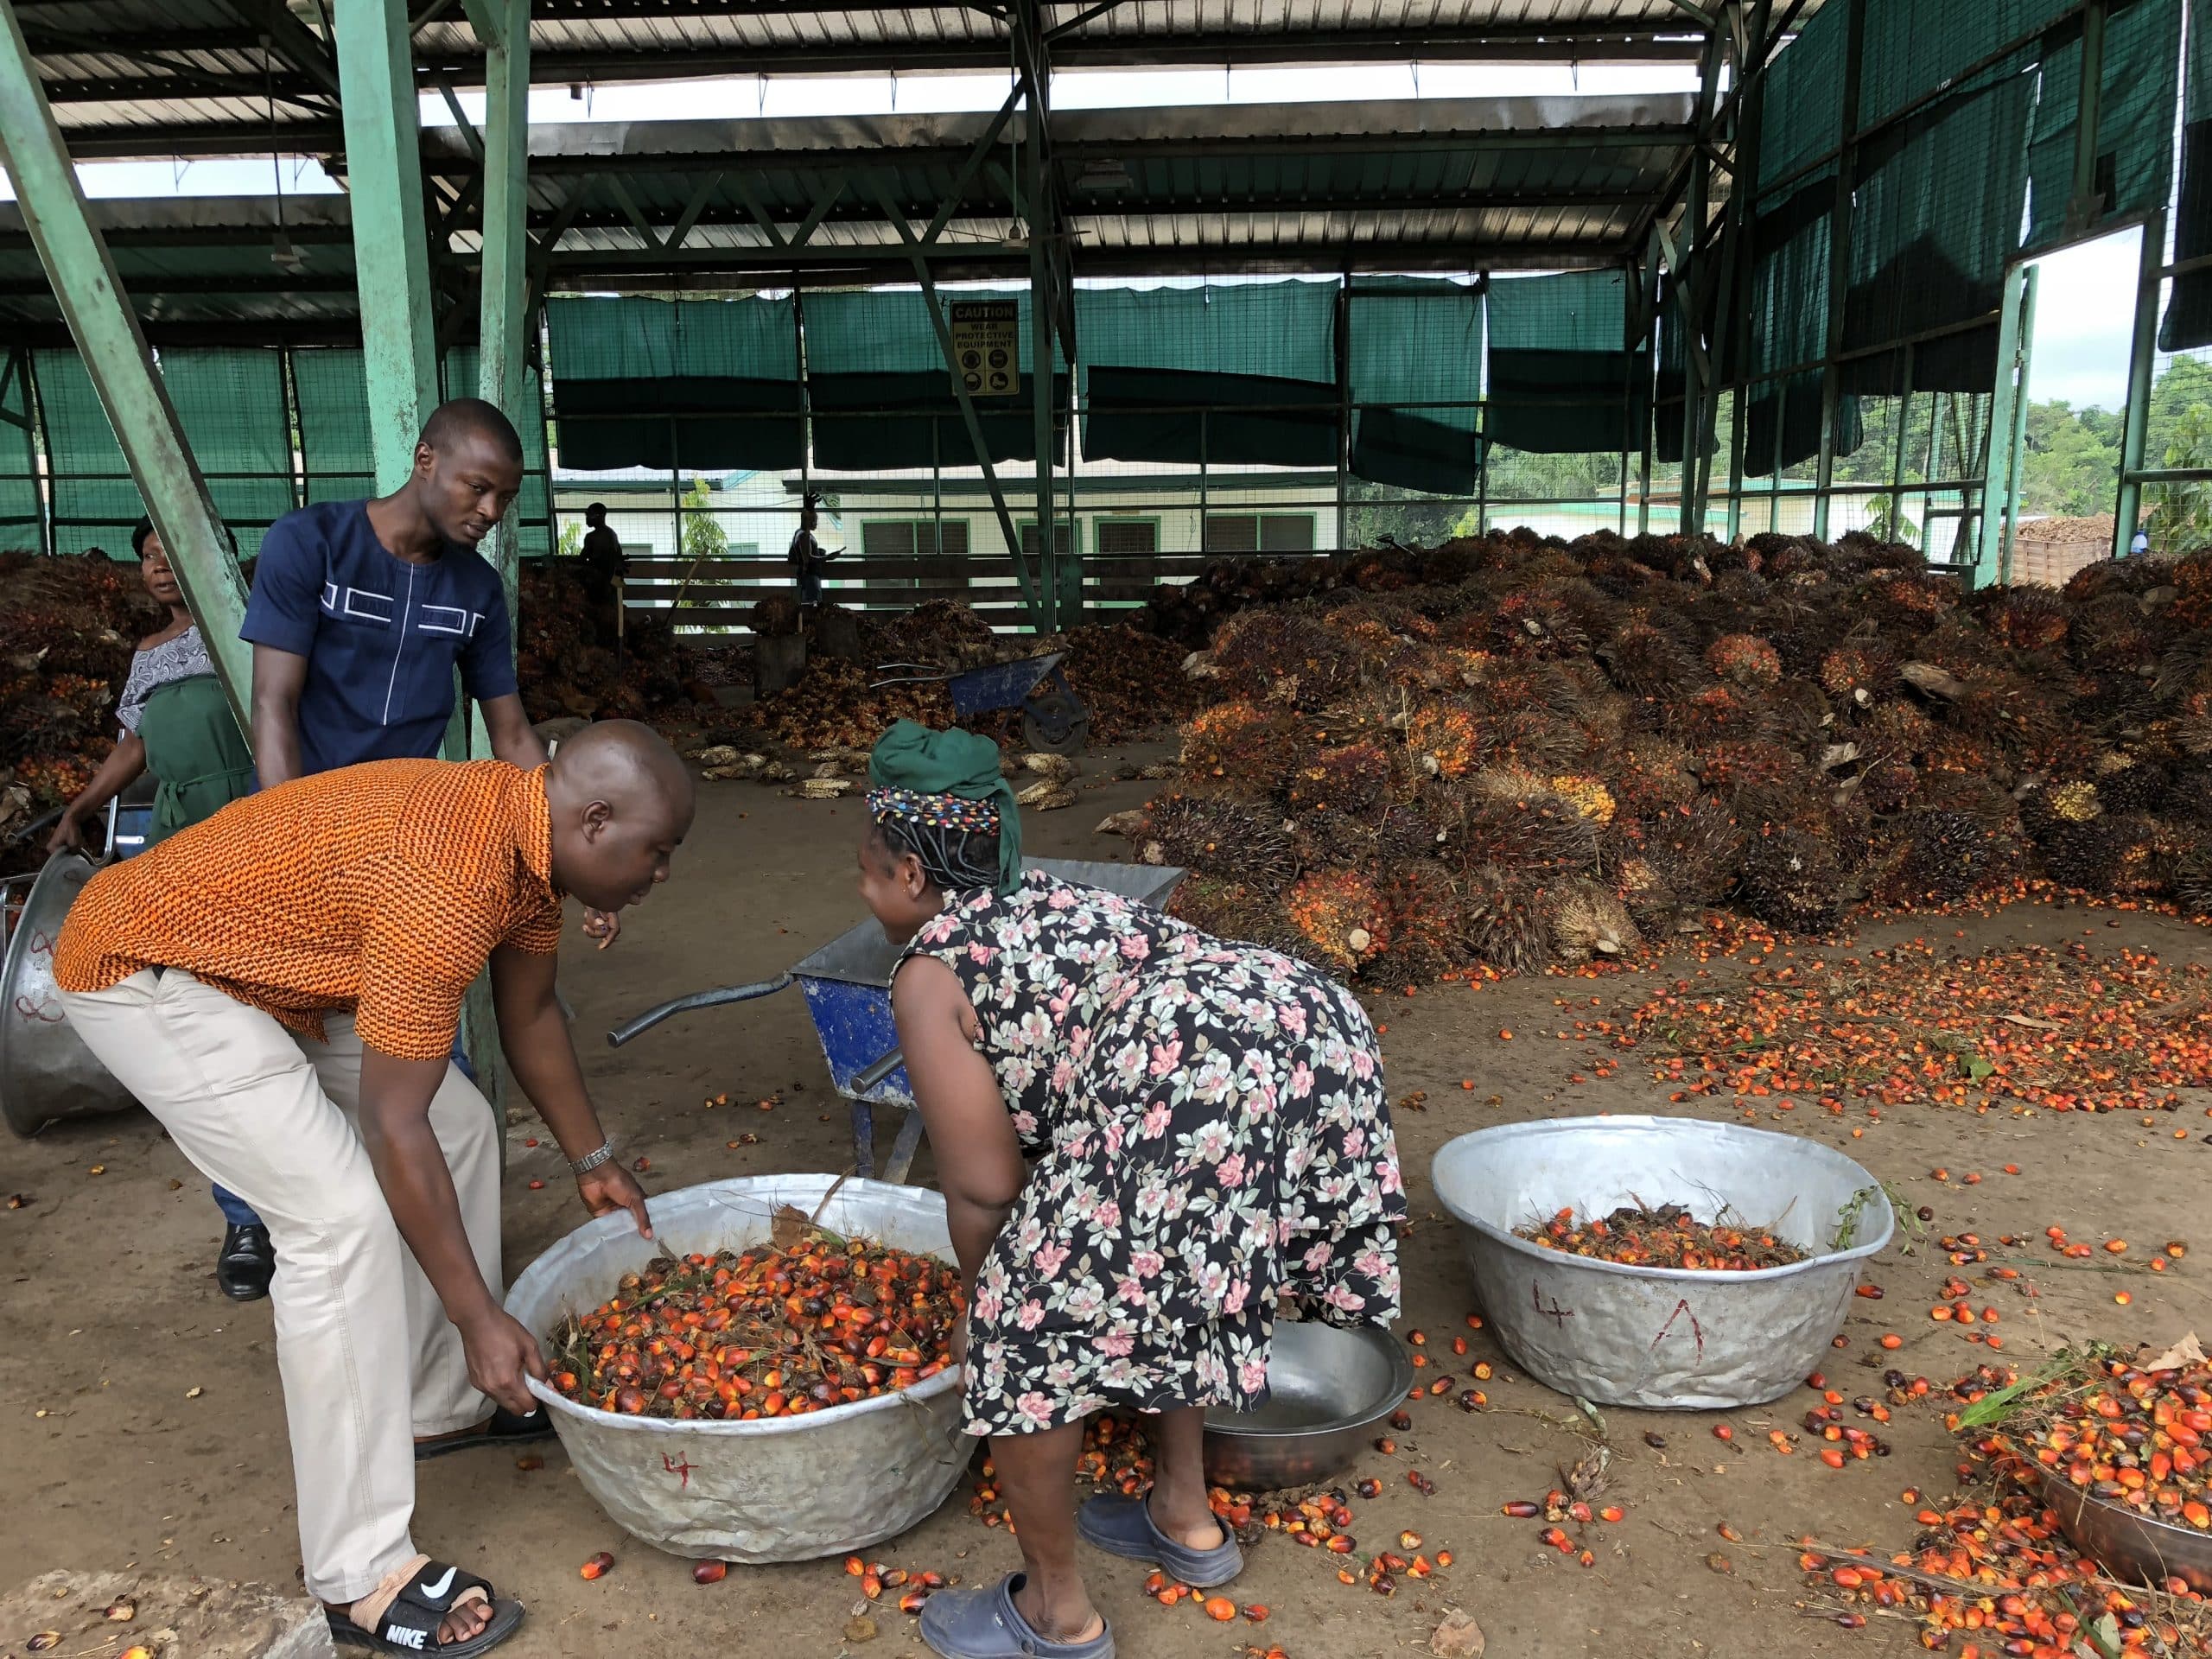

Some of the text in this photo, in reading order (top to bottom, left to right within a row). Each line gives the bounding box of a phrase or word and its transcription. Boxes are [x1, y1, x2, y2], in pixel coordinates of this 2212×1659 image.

[955, 305, 1014, 319] CAUTION
[956, 331, 1014, 340] PROTECTIVE
[1532, 1279, 1575, 1329] 4
[661, 1450, 702, 1491] 4
[385, 1624, 428, 1649] NIKE
